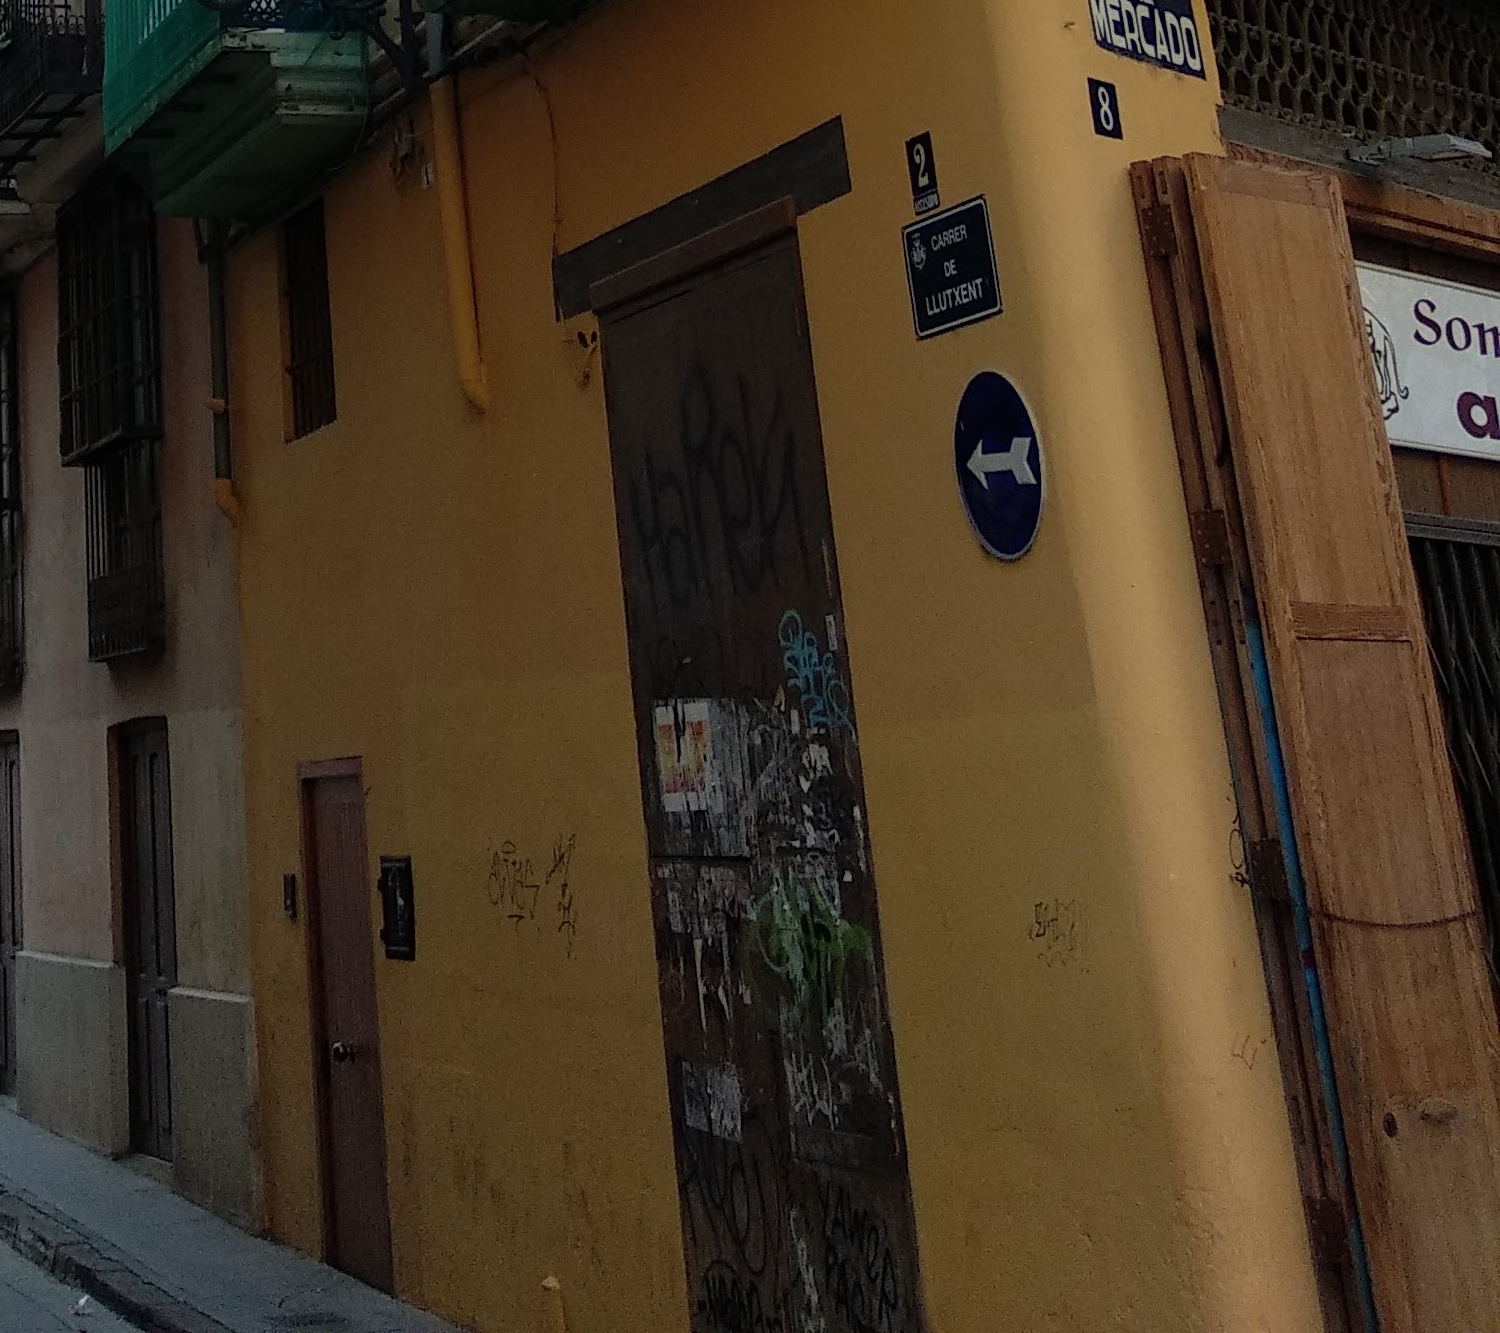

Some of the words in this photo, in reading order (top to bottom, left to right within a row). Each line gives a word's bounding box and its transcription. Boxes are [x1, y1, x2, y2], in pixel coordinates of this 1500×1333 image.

[1097, 86, 1114, 130] 8
[913, 143, 929, 187] 2
[931, 224, 968, 251] CARRER
[943, 259, 957, 277] DE
[925, 278, 983, 316] LLUTXENT
